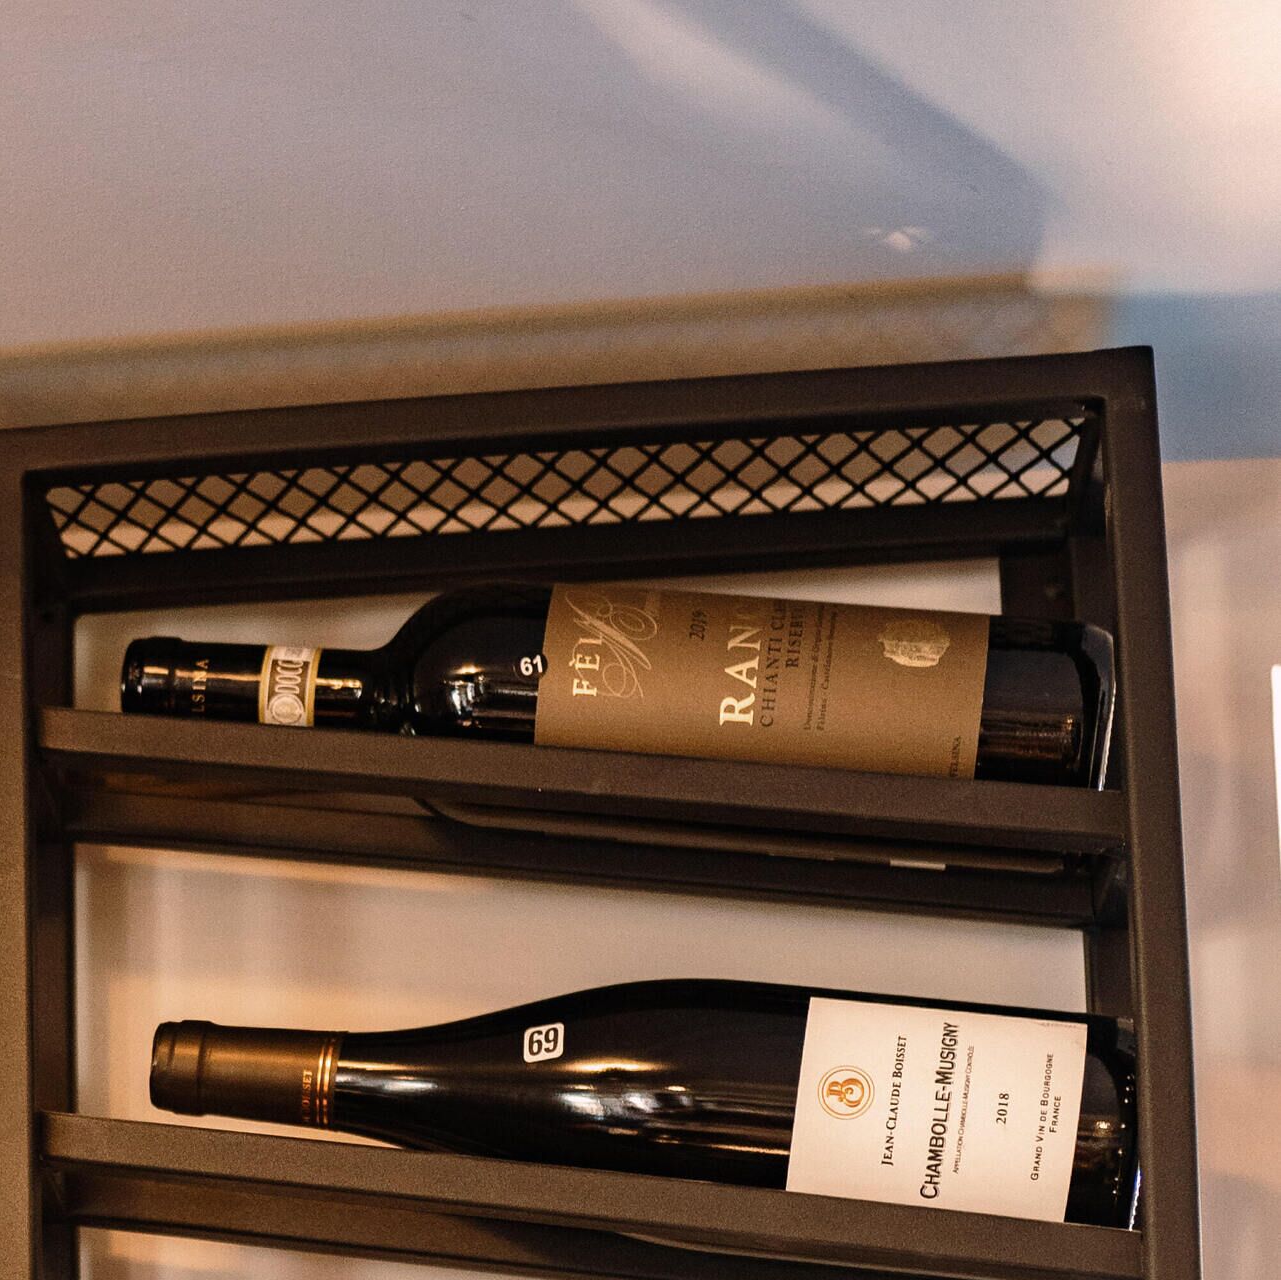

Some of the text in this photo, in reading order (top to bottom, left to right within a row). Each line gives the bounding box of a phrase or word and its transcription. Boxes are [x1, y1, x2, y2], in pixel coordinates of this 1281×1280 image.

[520, 656, 544, 677] 61
[759, 637, 783, 728] CHIANTI
[527, 1026, 560, 1058] 69
[881, 1035, 908, 1167] JEAN-CLAUDE BOISSET
[919, 1022, 958, 1200] CHAMBOLLE-MUSIGNY
[996, 1092, 1010, 1126] 2018
[1030, 1052, 1054, 1181] GRAND VIN DE BOURGOGNE
[1049, 1095, 1061, 1133] FRANCE
[952, 1136, 965, 1175] APPELLATION
